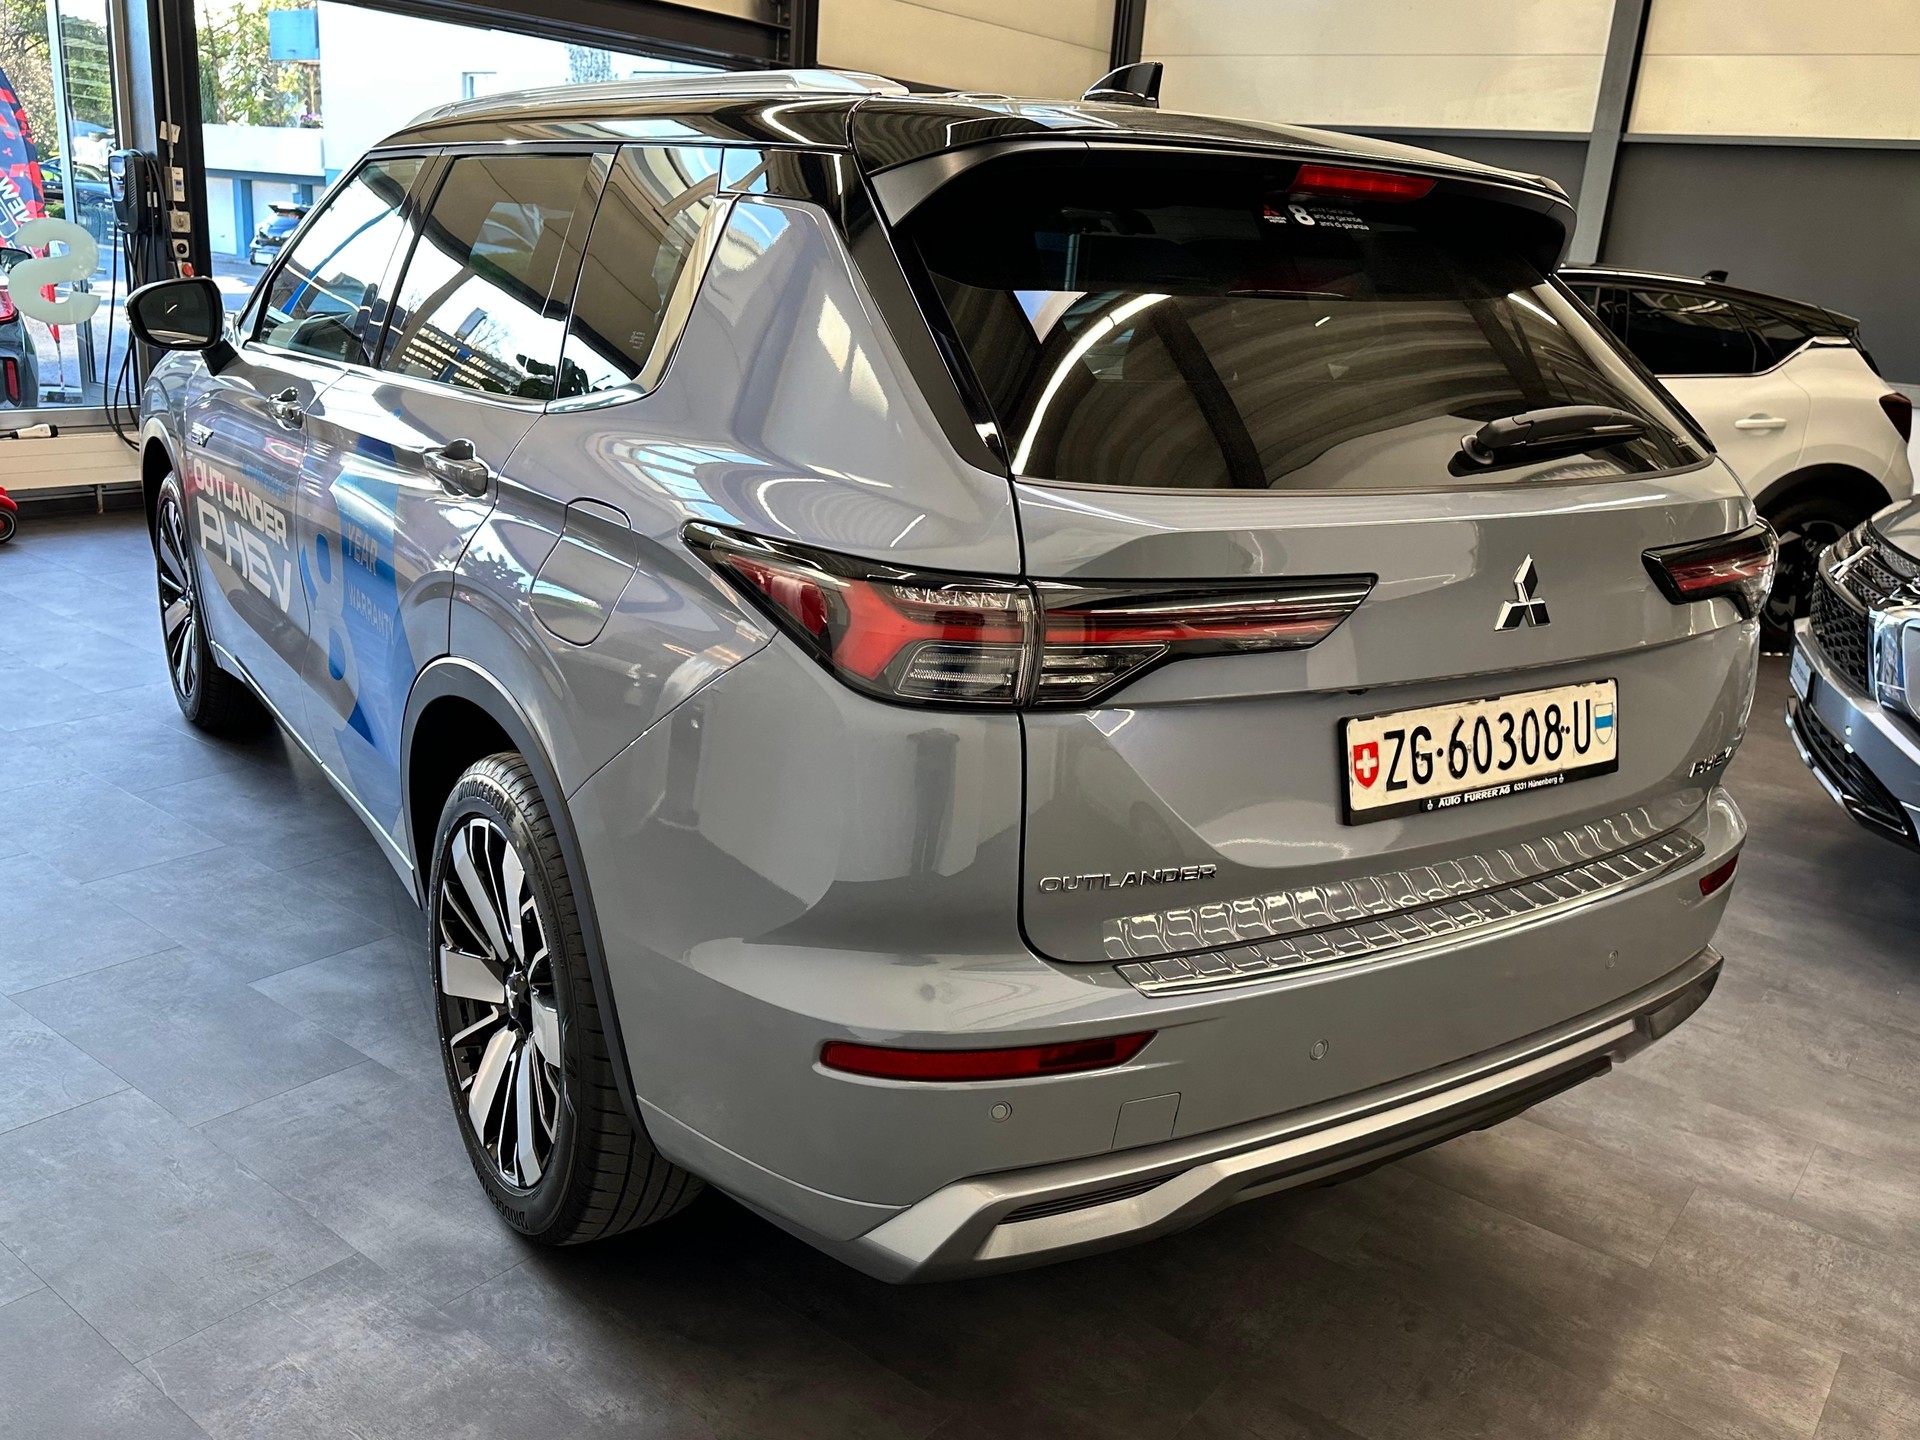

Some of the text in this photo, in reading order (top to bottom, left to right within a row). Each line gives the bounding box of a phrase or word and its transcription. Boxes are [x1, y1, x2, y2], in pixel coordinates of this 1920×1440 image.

[1287, 204, 1315, 226] 8
[193, 457, 290, 551] OUTLANDER
[196, 495, 292, 614] PHEV
[345, 522, 379, 577] YEAR
[345, 578, 396, 647] WARRANTY
[457, 779, 517, 828] BRIDGESTONE
[1464, 788, 1498, 803] FURRER
[1498, 785, 1511, 796] AG
[1513, 781, 1527, 791] 6331
[1527, 776, 1558, 789] Hünenberg
[1039, 863, 1217, 892] OUTLANDER
